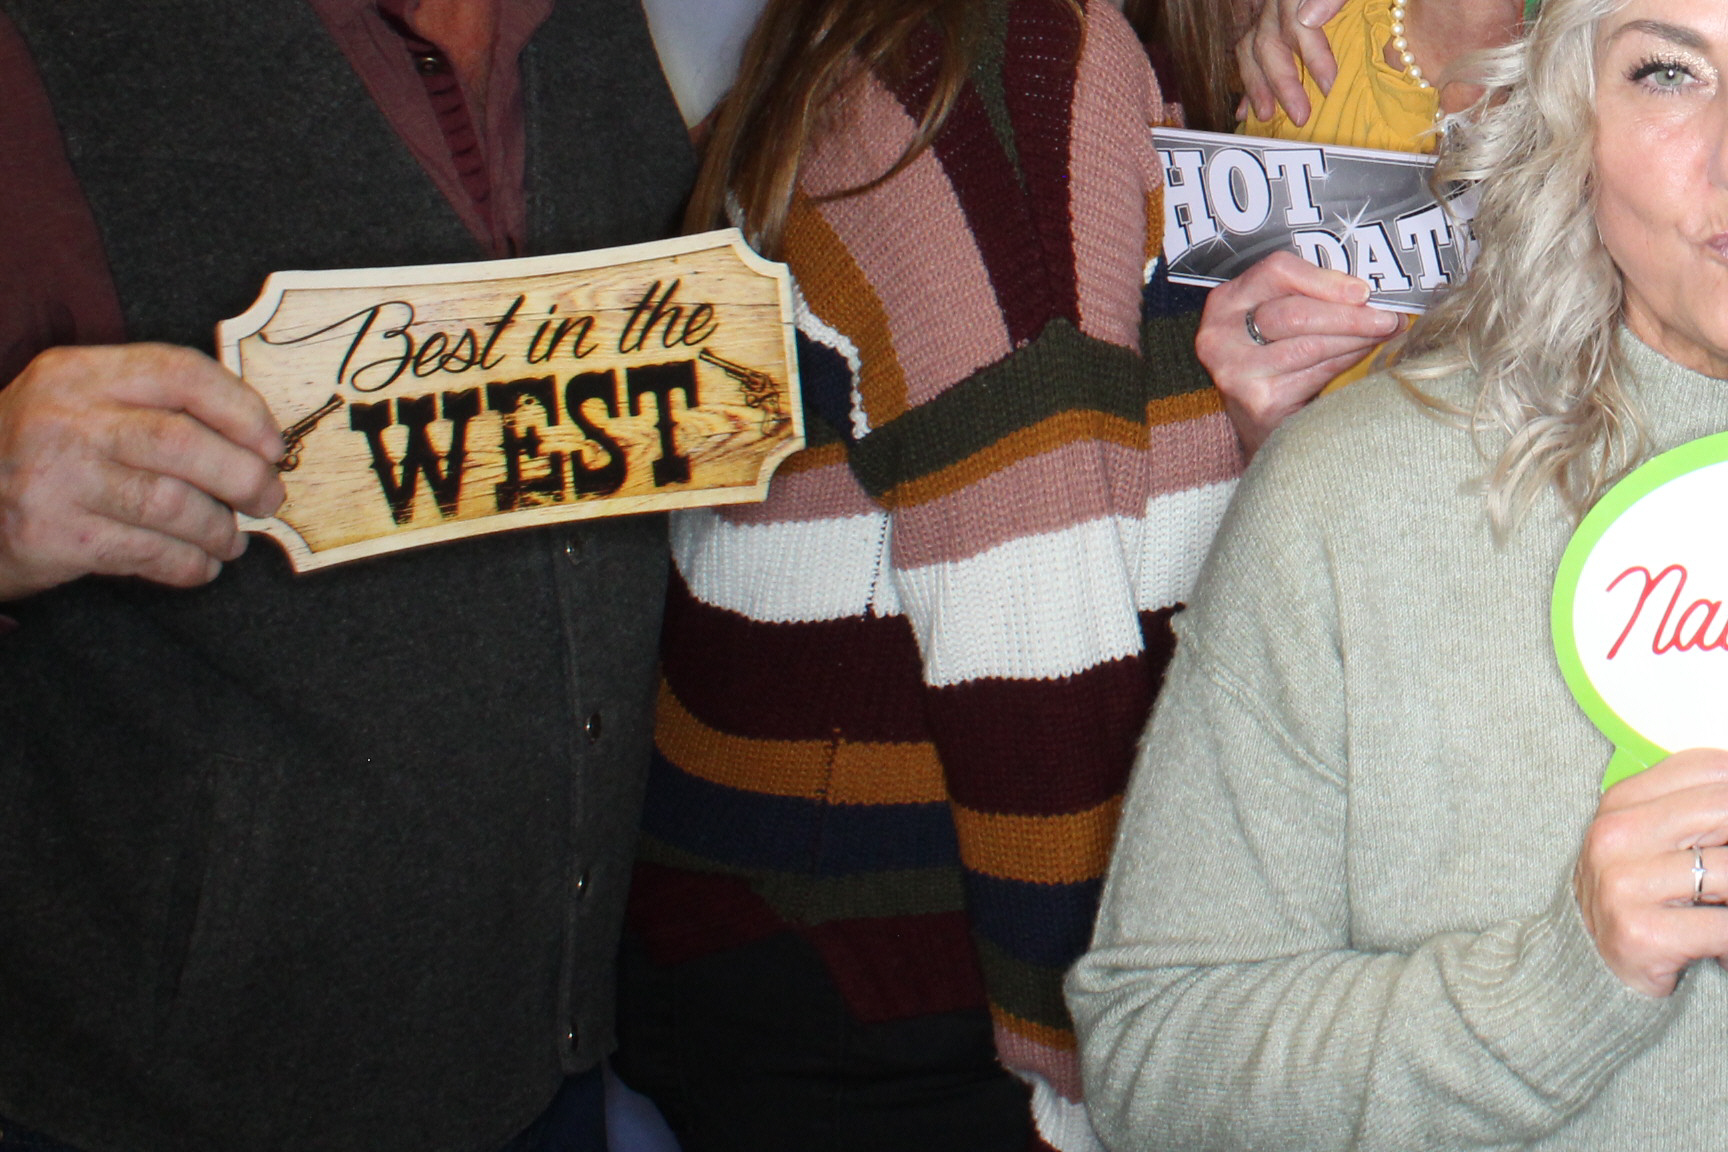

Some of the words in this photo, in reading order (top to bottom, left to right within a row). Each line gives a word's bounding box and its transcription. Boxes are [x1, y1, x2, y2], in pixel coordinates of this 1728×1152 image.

[1158, 148, 1328, 266] HOT
[258, 295, 527, 393] Best
[527, 304, 599, 362] in
[619, 278, 719, 354] the
[349, 359, 700, 526] WEST
